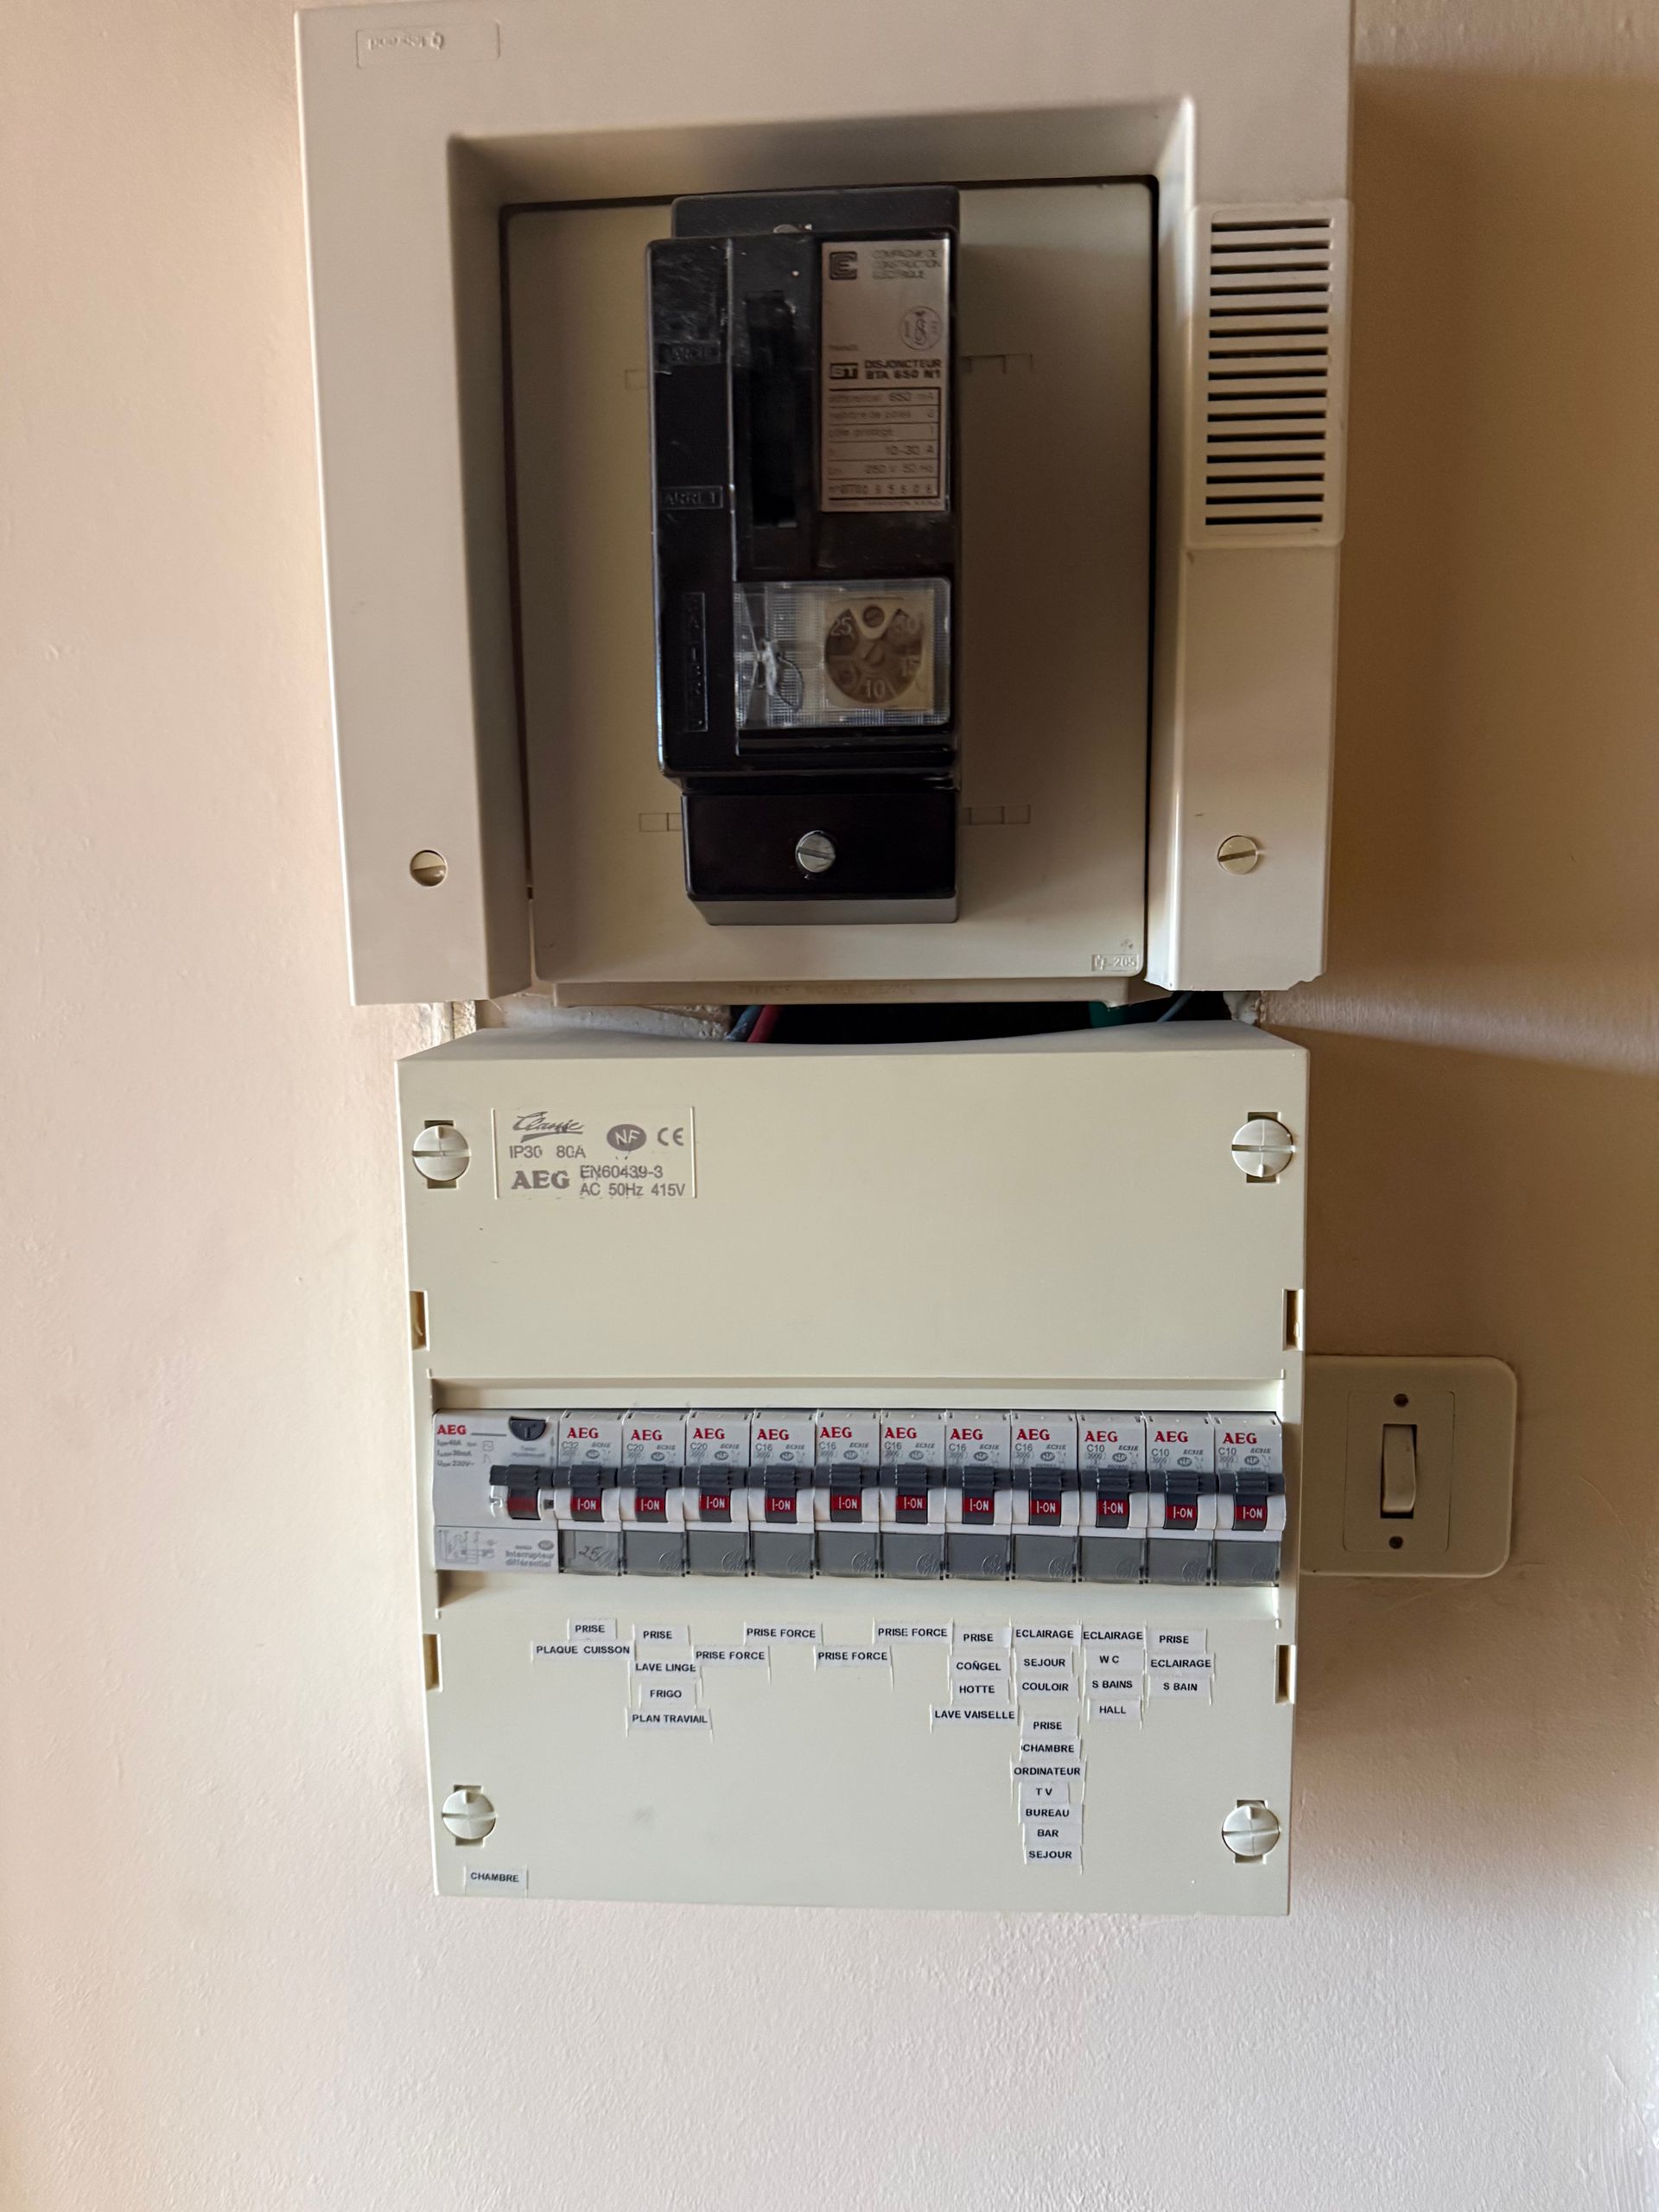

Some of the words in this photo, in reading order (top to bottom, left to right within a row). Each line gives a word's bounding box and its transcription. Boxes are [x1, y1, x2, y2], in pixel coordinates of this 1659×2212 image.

[865, 359, 941, 369] DISJONCTEUR
[864, 677, 885, 700] 10
[657, 1127, 684, 1147] CE
[509, 1145, 543, 1159] IP30
[556, 1145, 586, 1159] 80A
[580, 1165, 664, 1179] EN60439-3
[512, 1170, 570, 1190] AEG
[580, 1183, 601, 1197] AC
[608, 1183, 644, 1197] 50Hz
[651, 1183, 686, 1197] 415V
[436, 1424, 467, 1435] AEG
[567, 1427, 599, 1439] AEG
[631, 1429, 663, 1440] AEG
[692, 1427, 725, 1440] AEG
[757, 1428, 790, 1440] AEG
[819, 1427, 853, 1438] AEG
[884, 1427, 918, 1439] AEG
[950, 1428, 983, 1440] AEG
[1016, 1428, 1051, 1440] AEG
[1084, 1431, 1118, 1443] AEG
[1154, 1431, 1189, 1443] AEG
[1223, 1433, 1257, 1445] AEG
[562, 1441, 579, 1450] C32
[626, 1443, 644, 1452] C20
[690, 1442, 708, 1451] C20
[755, 1443, 773, 1452] C16
[884, 1441, 902, 1450] C16
[949, 1443, 966, 1452] C16
[1014, 1443, 1033, 1452] C16
[1087, 1444, 1105, 1452] C10
[1151, 1448, 1170, 1457] C10
[1218, 1447, 1237, 1456] C10
[575, 1624, 606, 1634] PRISE
[747, 1628, 777, 1637] PRISE
[780, 1629, 817, 1638] FORCE
[878, 1628, 909, 1637] PRISE
[912, 1628, 948, 1637] FORCE
[643, 1630, 673, 1640] PRISE
[963, 1632, 994, 1643] PRISE
[1015, 1630, 1074, 1639] ECLAIRAGE
[1083, 1630, 1143, 1641] ECLAIRAGE
[1159, 1635, 1190, 1644] PRISE
[536, 1645, 579, 1656] PLAQUE
[583, 1645, 631, 1655] CUISSON
[696, 1650, 727, 1660] PRISE
[729, 1651, 766, 1661] FORCE
[818, 1651, 849, 1660] PRISE
[851, 1651, 887, 1661] FORCE
[635, 1662, 663, 1672] LAVE
[665, 1662, 696, 1672] LINGE
[1023, 1657, 1066, 1667] SEJOUR
[1150, 1658, 1212, 1669] ECLAIRAGE
[959, 1684, 995, 1694] HOTTE
[1021, 1681, 1069, 1692] COULOIR
[1091, 1680, 1098, 1689] S
[1100, 1680, 1134, 1689] BAINS
[1163, 1681, 1170, 1691] S
[1172, 1682, 1198, 1692] BAIN
[650, 1689, 683, 1699] FRIGO
[1099, 1705, 1127, 1714] HALL
[632, 1714, 661, 1724] PLAN
[664, 1714, 709, 1724] TRAVIAIL
[934, 1710, 962, 1719] LAVE
[963, 1710, 1015, 1720] VAISELLE
[1033, 1721, 1063, 1731] PRISE
[1022, 1744, 1075, 1753] CHAMBRE
[1014, 1767, 1081, 1777] ORDINATEUR
[1025, 1808, 1070, 1818] BUREAU
[1037, 1828, 1059, 1838] BAR
[1028, 1850, 1073, 1859] SEJOUR
[470, 1872, 519, 1883] CHAMBRE
